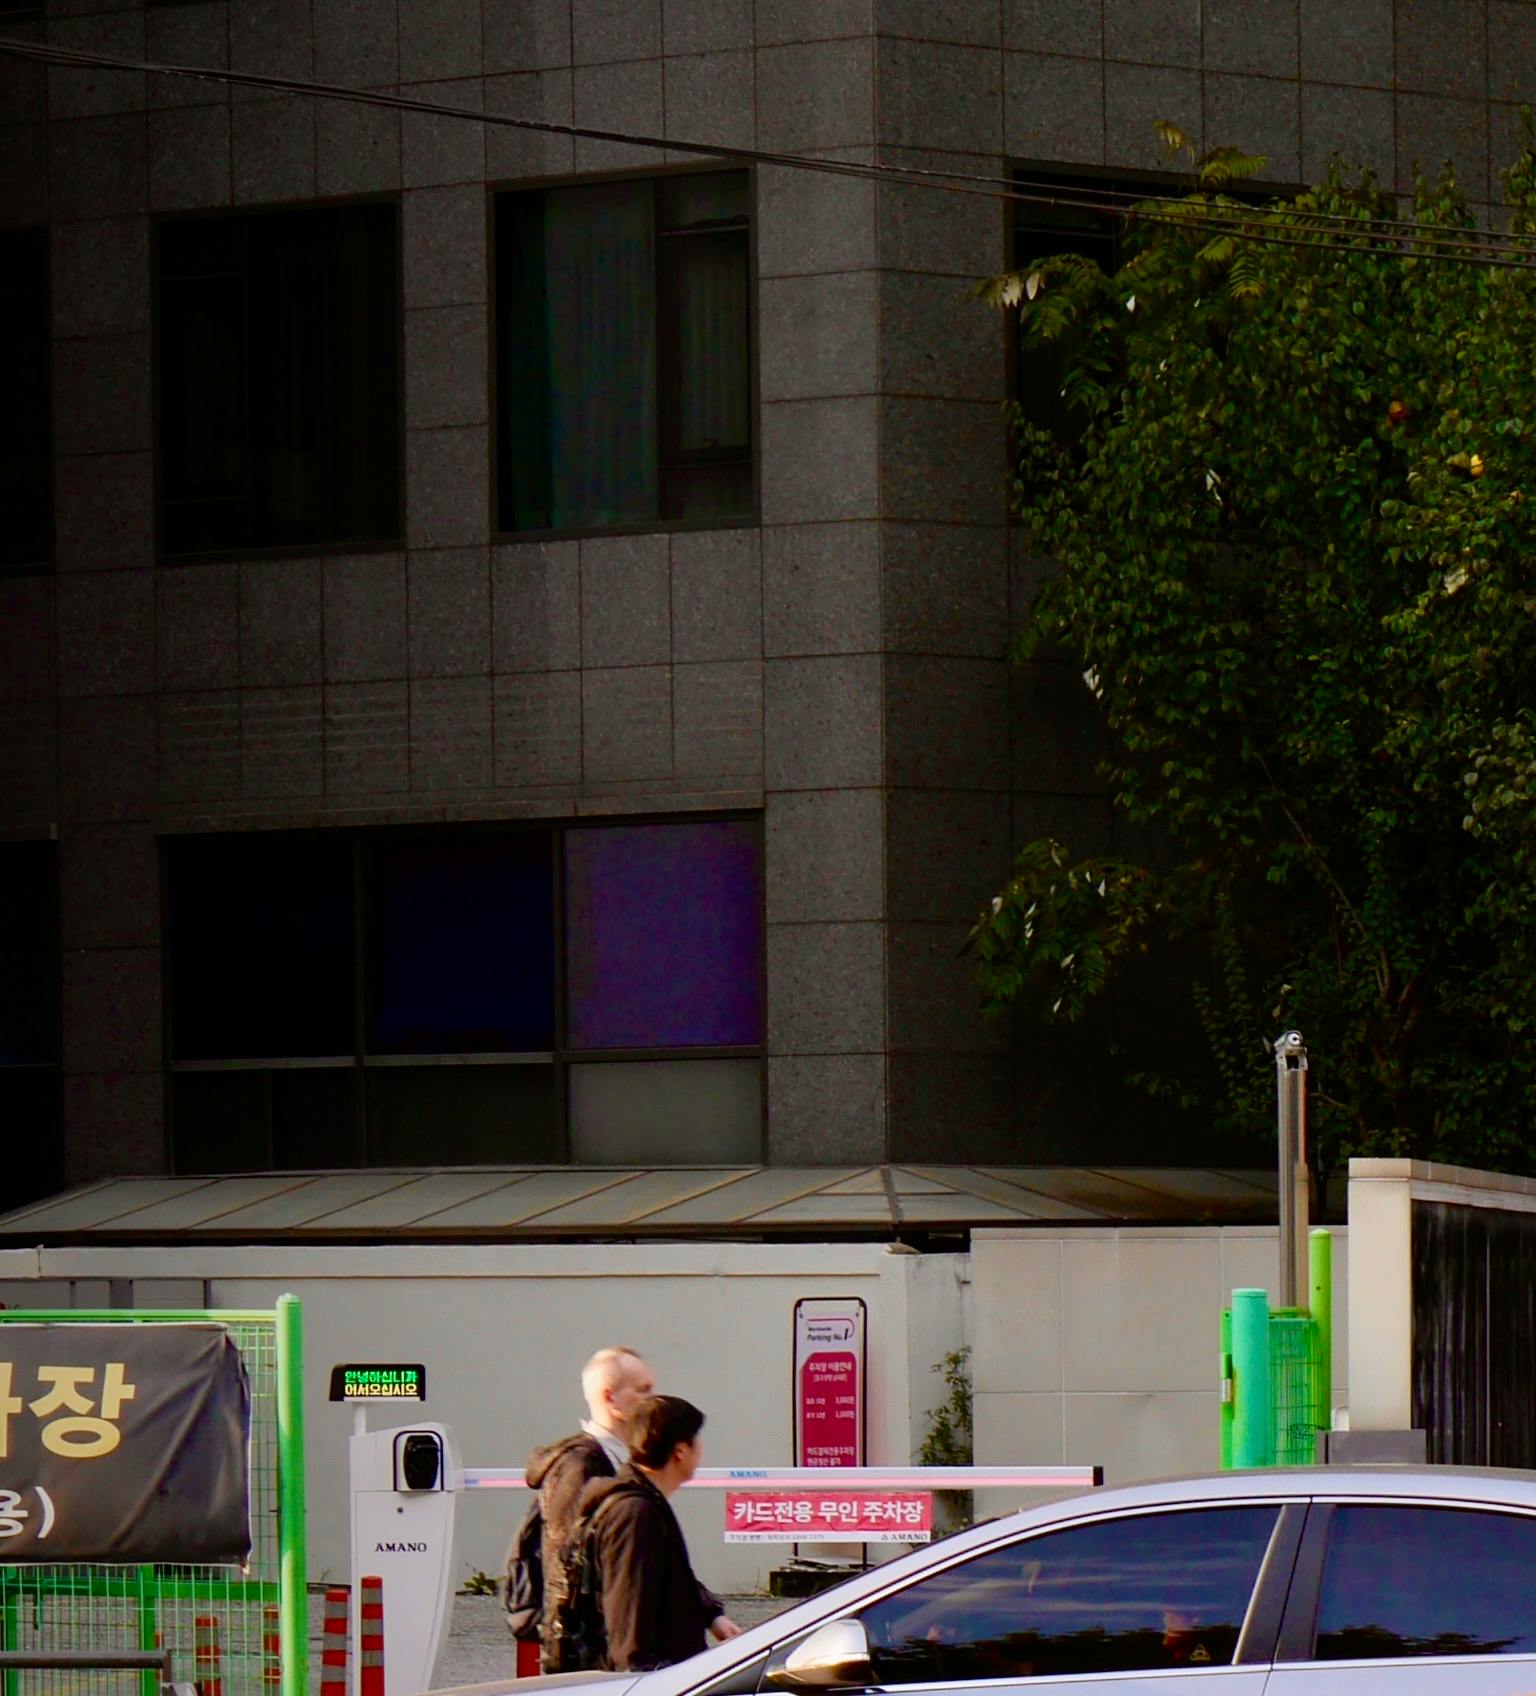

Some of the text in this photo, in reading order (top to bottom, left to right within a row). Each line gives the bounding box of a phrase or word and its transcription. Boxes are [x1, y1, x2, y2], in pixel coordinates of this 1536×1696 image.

[344, 1383, 418, 1396] 어서오십시오
[729, 1470, 768, 1478] AMANO
[733, 1500, 924, 1524] 카드전용 무인 주차장
[890, 1533, 928, 1542] AMANO
[374, 1542, 428, 1553] AMANO
